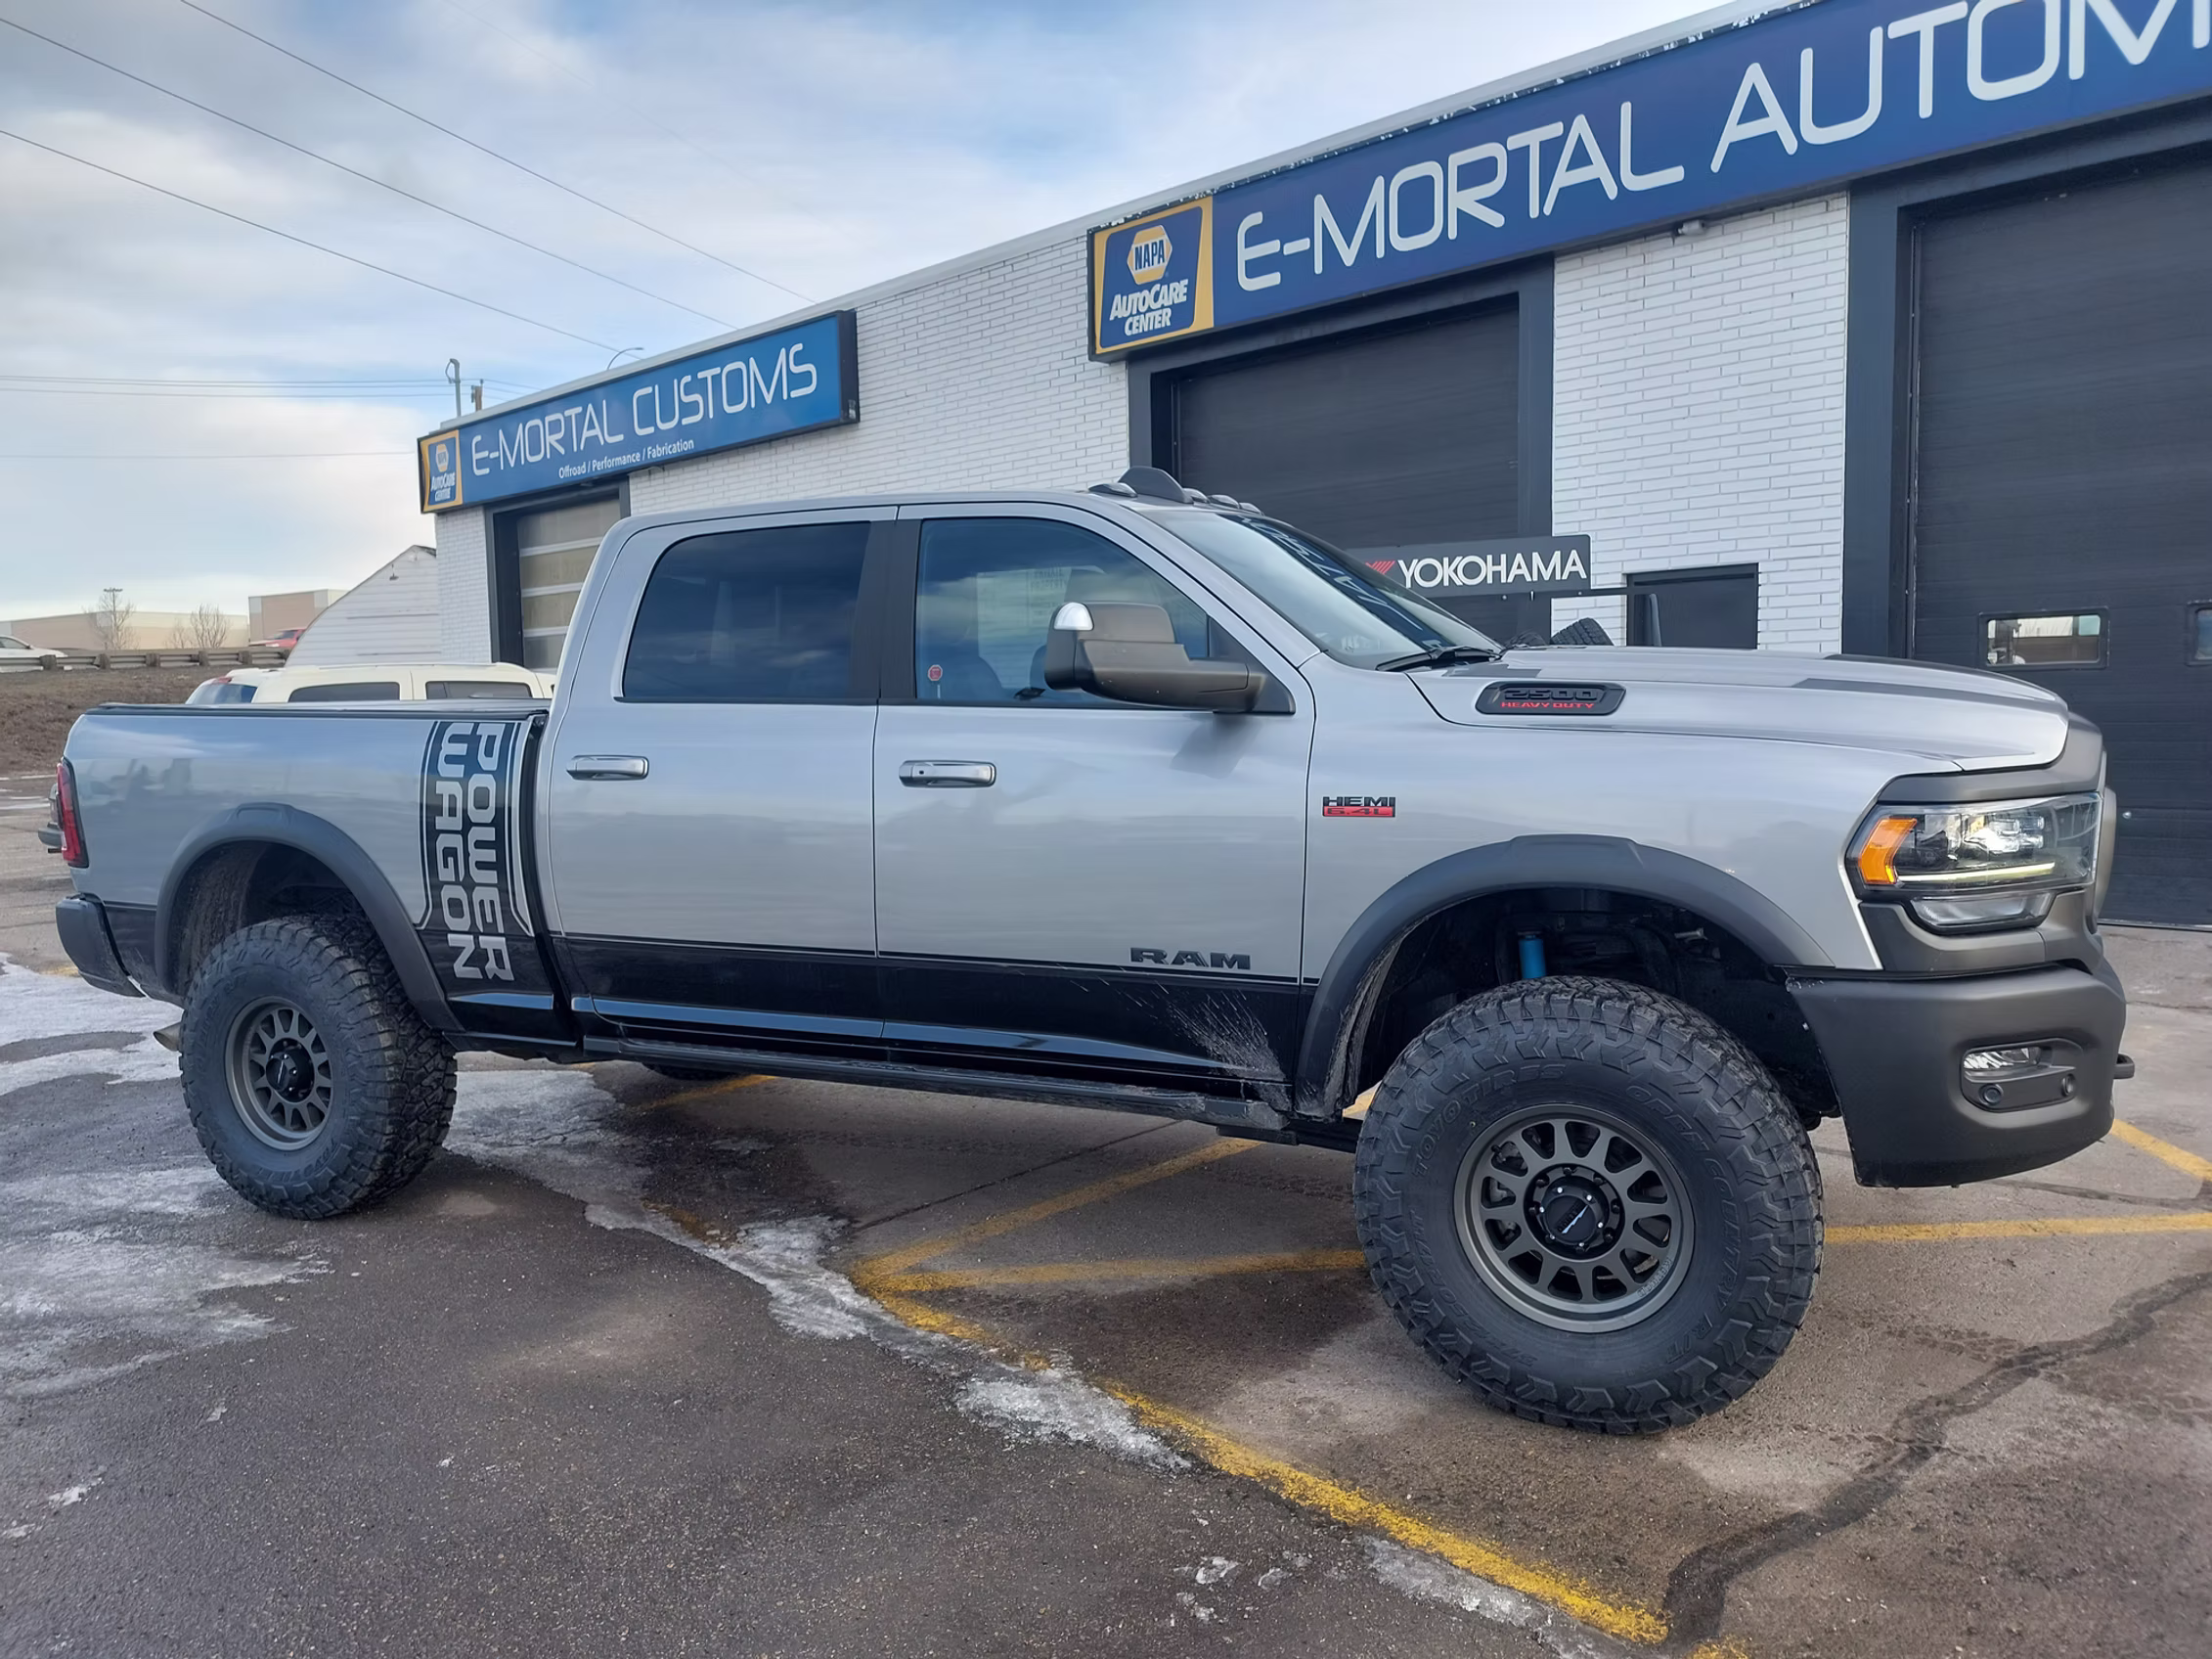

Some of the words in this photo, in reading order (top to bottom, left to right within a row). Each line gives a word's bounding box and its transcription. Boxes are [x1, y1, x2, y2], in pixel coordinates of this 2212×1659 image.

[1236, 100, 1685, 291] E-MORTAL
[1133, 239, 1166, 271] NAPA
[1109, 278, 1189, 321] AUTOCARE
[1125, 307, 1172, 336] CENTER
[471, 399, 624, 476] E-MORTAL
[632, 342, 818, 437] CUSTOMS
[558, 462, 587, 479] Offroad
[592, 451, 641, 471] Performance
[646, 438, 694, 460] Fabrication
[1397, 549, 1588, 589] YOKOHAMA
[1504, 689, 1599, 700] 2500
[1322, 795, 1396, 807] HEMI
[435, 722, 484, 979] WAGON
[467, 722, 514, 981] POWER
[1129, 947, 1251, 970] RAM
[1415, 1099, 1462, 1177] TOYO
[1463, 1063, 1566, 1105] TIRES
